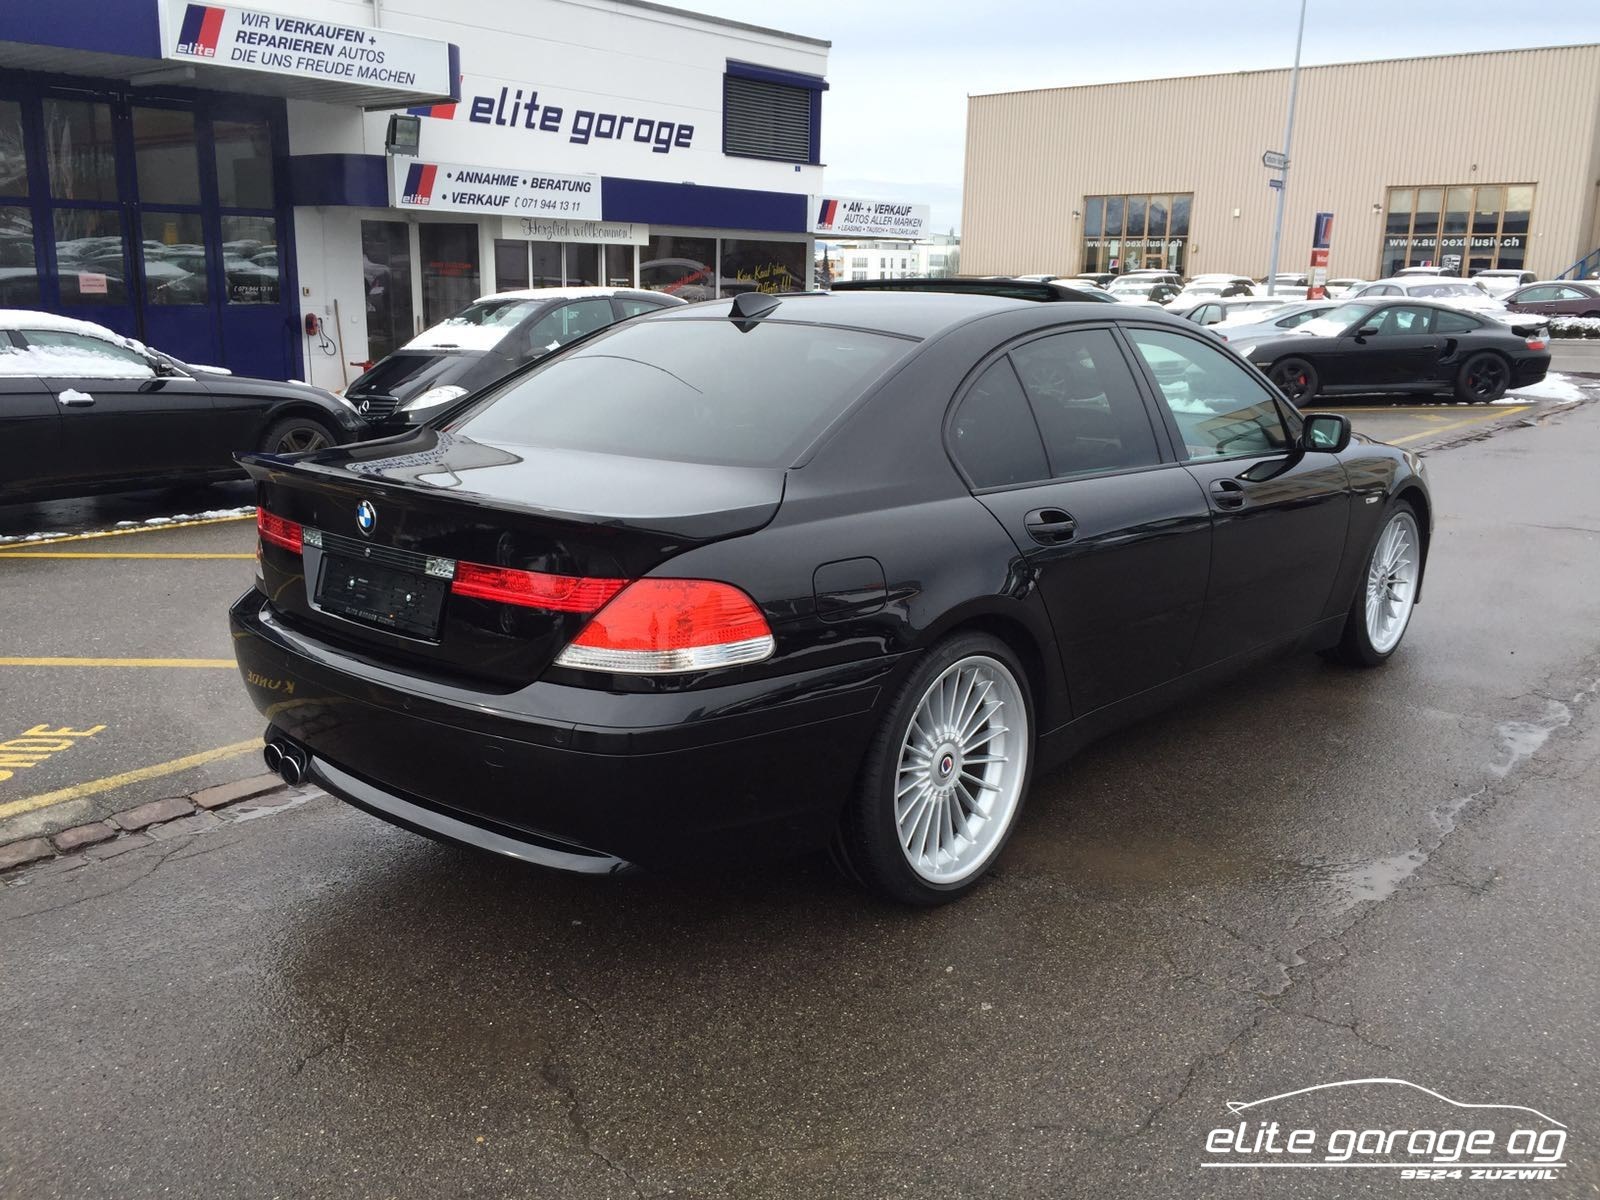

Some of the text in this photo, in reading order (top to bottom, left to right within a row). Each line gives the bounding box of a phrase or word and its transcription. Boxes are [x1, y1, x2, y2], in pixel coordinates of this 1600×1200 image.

[241, 12, 270, 29] WIR
[275, 17, 365, 44] VERKAUFEN
[176, 43, 215, 57] elite
[235, 31, 385, 64] REPARIEREN AUTOS
[231, 48, 416, 85] DIE UNS FREUDE MACHEN
[469, 86, 694, 154] elite garage
[455, 171, 592, 193] ANNAHME BERATUNG
[402, 194, 431, 206] elite
[452, 192, 581, 212] VERKAUF 071 944 13 11
[848, 202, 864, 213] AN-
[874, 204, 912, 216] VERKAUF
[520, 217, 570, 240] Herzlich
[841, 224, 862, 233] LEASING
[844, 213, 923, 228] AUTOS ALLER MARKEN
